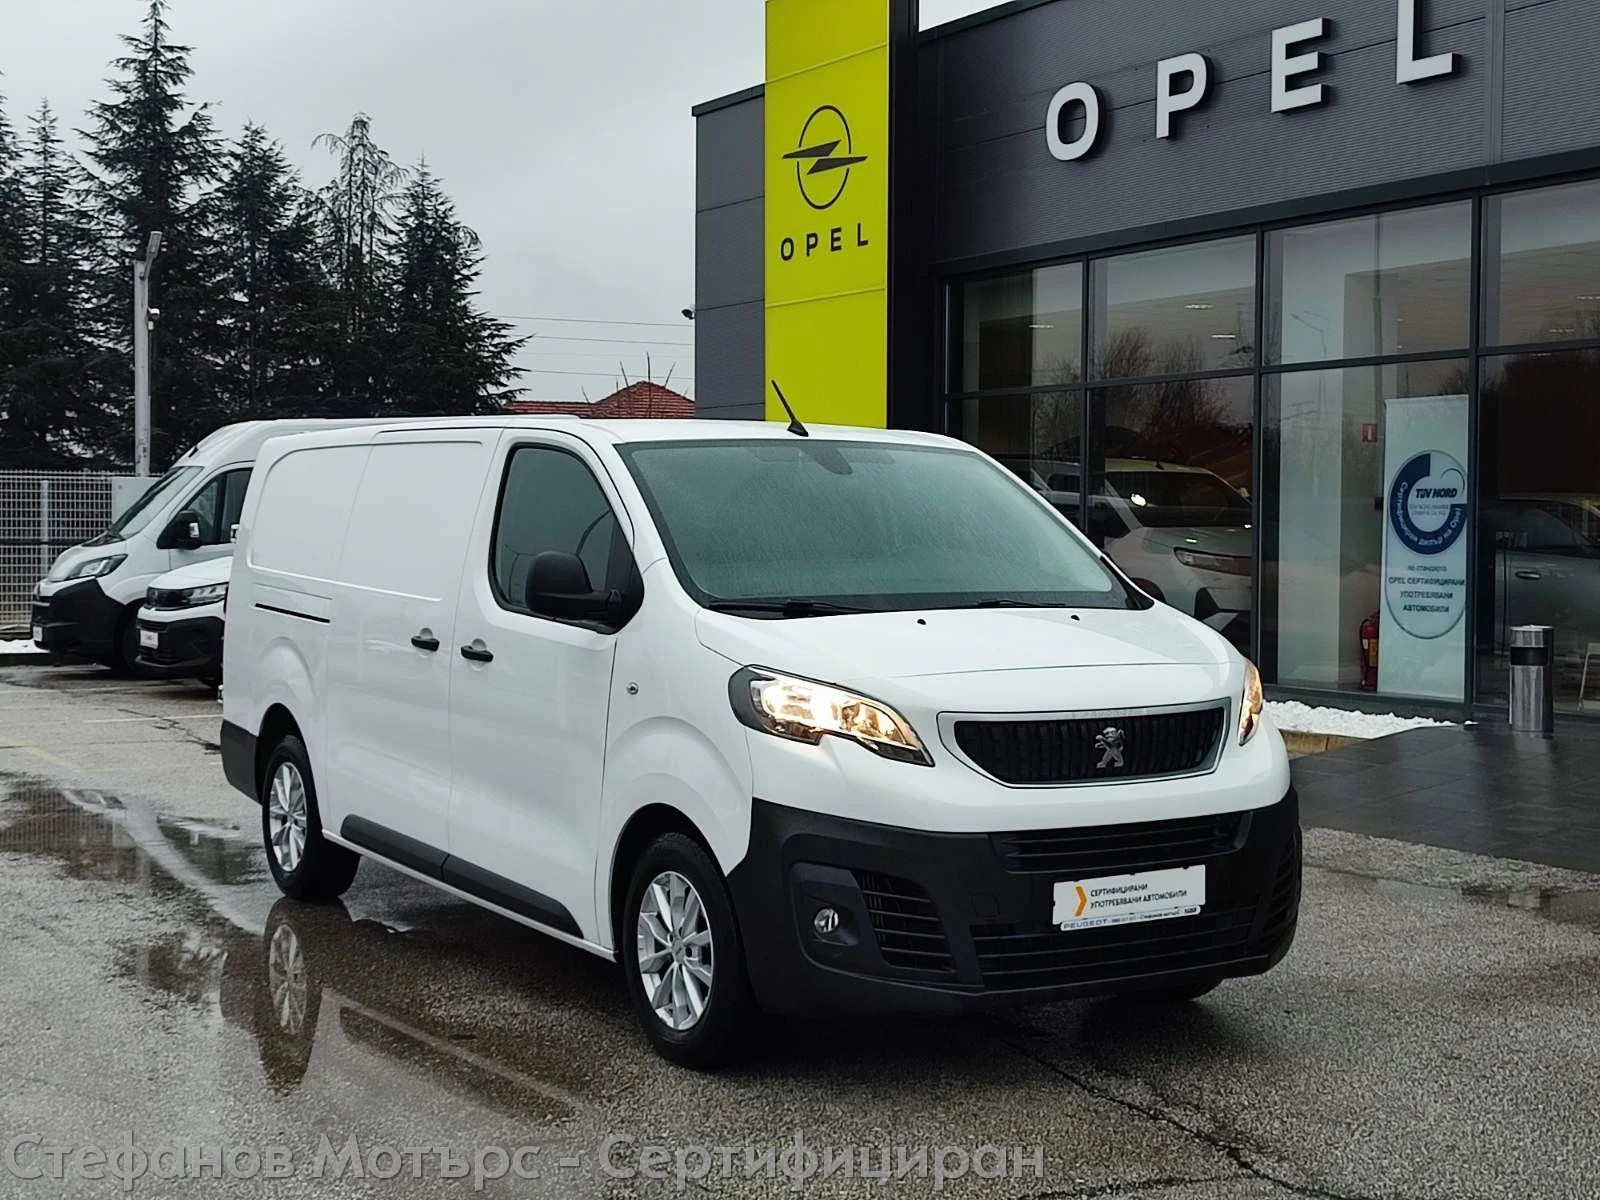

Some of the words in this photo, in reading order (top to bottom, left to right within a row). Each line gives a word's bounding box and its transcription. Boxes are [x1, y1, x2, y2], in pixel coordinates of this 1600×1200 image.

[1046, 0, 1454, 162] OPEL
[780, 222, 869, 262] OPEL
[1432, 487, 1458, 499] NORD
[1388, 576, 1406, 585] OPEL
[1090, 883, 1148, 897] СЕРТИФИЦИРАНИ
[1090, 896, 1142, 910] УПОТРЕБЯВАНИ
[1142, 890, 1188, 903] АВТОМОБИЛИ
[1063, 919, 1108, 929] PEUGEOT
